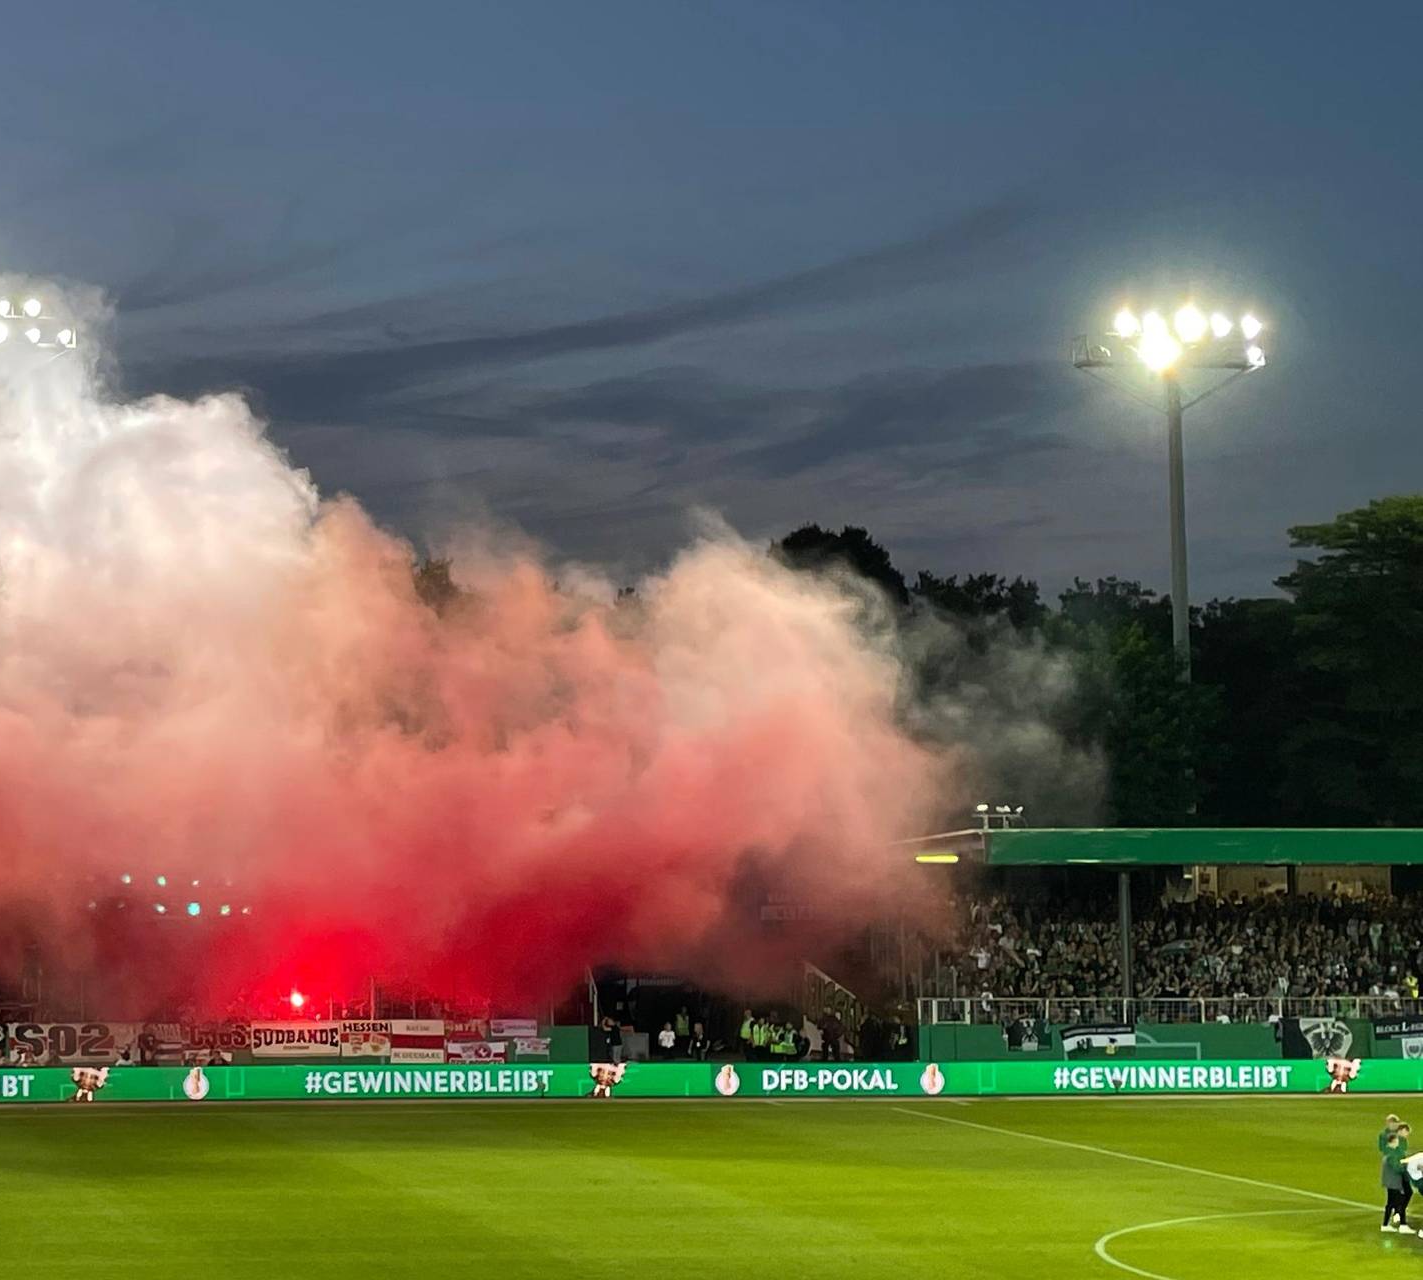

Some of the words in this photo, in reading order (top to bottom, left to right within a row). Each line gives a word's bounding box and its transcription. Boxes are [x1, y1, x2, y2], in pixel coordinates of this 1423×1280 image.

[342, 1022, 389, 1032] HESSEN
[305, 1070, 553, 1094] #GEWINNERBLEIBT
[761, 1069, 898, 1091] DFB-POKAL
[1054, 1066, 1292, 1090] #GEWINNERBLEIBT
